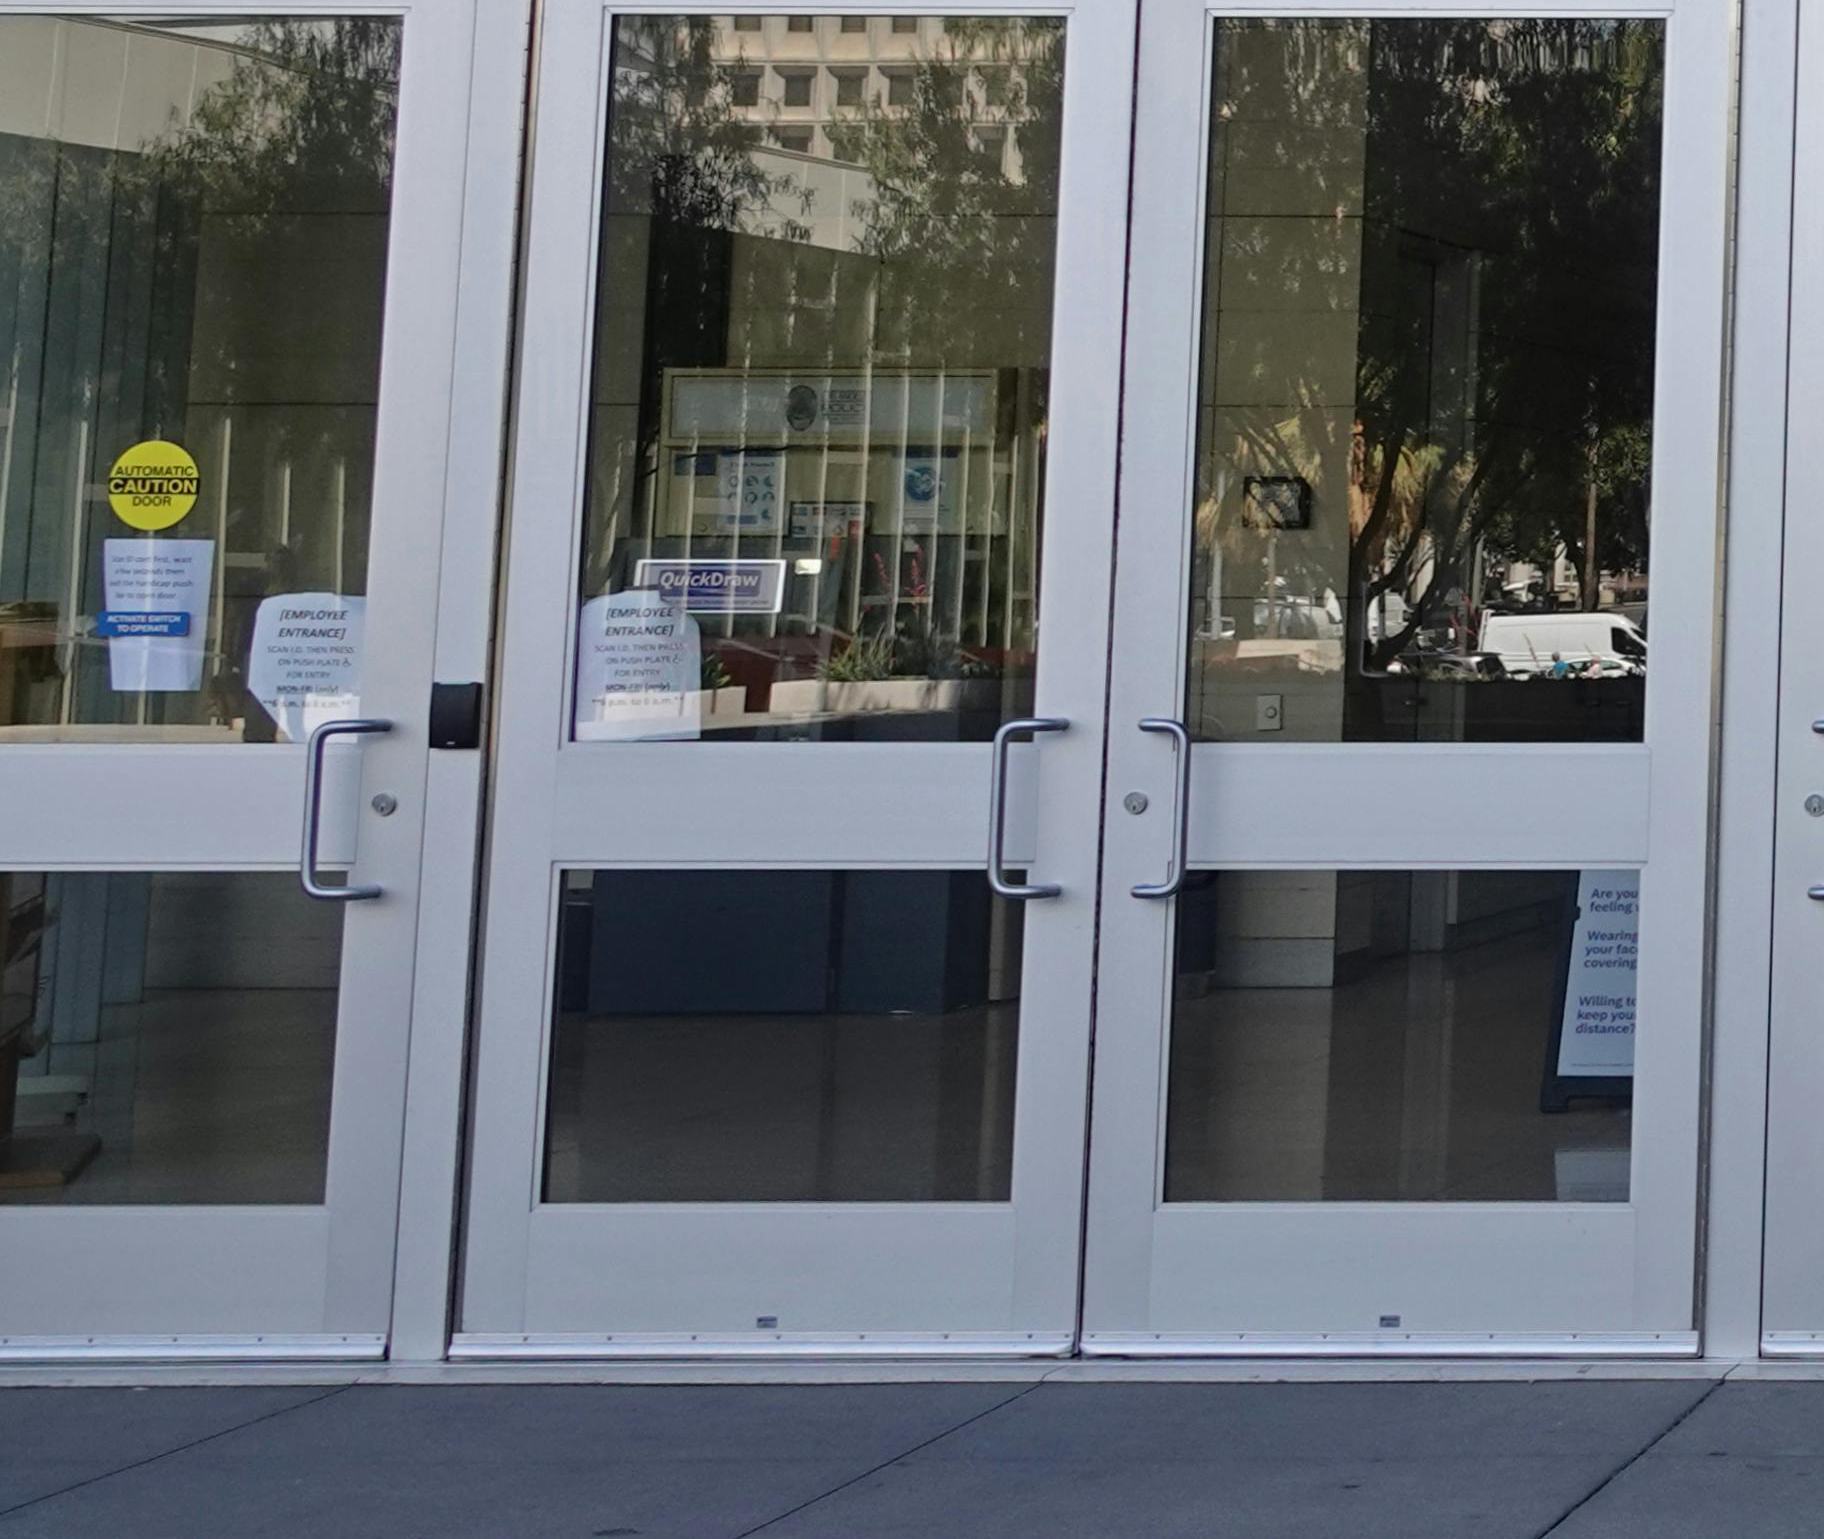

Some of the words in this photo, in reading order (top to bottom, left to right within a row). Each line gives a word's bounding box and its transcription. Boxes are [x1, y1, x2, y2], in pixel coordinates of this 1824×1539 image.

[115, 465, 194, 477] AUTOMATIC
[110, 479, 198, 494] CAUTION
[132, 496, 171, 507] DOOR
[660, 571, 759, 589] QuickDraw
[280, 609, 349, 621] [EMPLOYEE
[606, 608, 674, 620] [EMPLOYEE
[277, 628, 347, 641] ENTRANCE]
[605, 624, 674, 638] ENTRANCE]
[1591, 889, 1613, 899] Are
[1616, 891, 1639, 902] you
[1590, 902, 1633, 916] feeling
[1585, 945, 1613, 957] your
[1616, 944, 1638, 955] fac
[1584, 958, 1638, 971] covering
[1579, 996, 1623, 1009] Willing
[1576, 1010, 1609, 1023] keep
[1575, 1023, 1636, 1035] distance?
